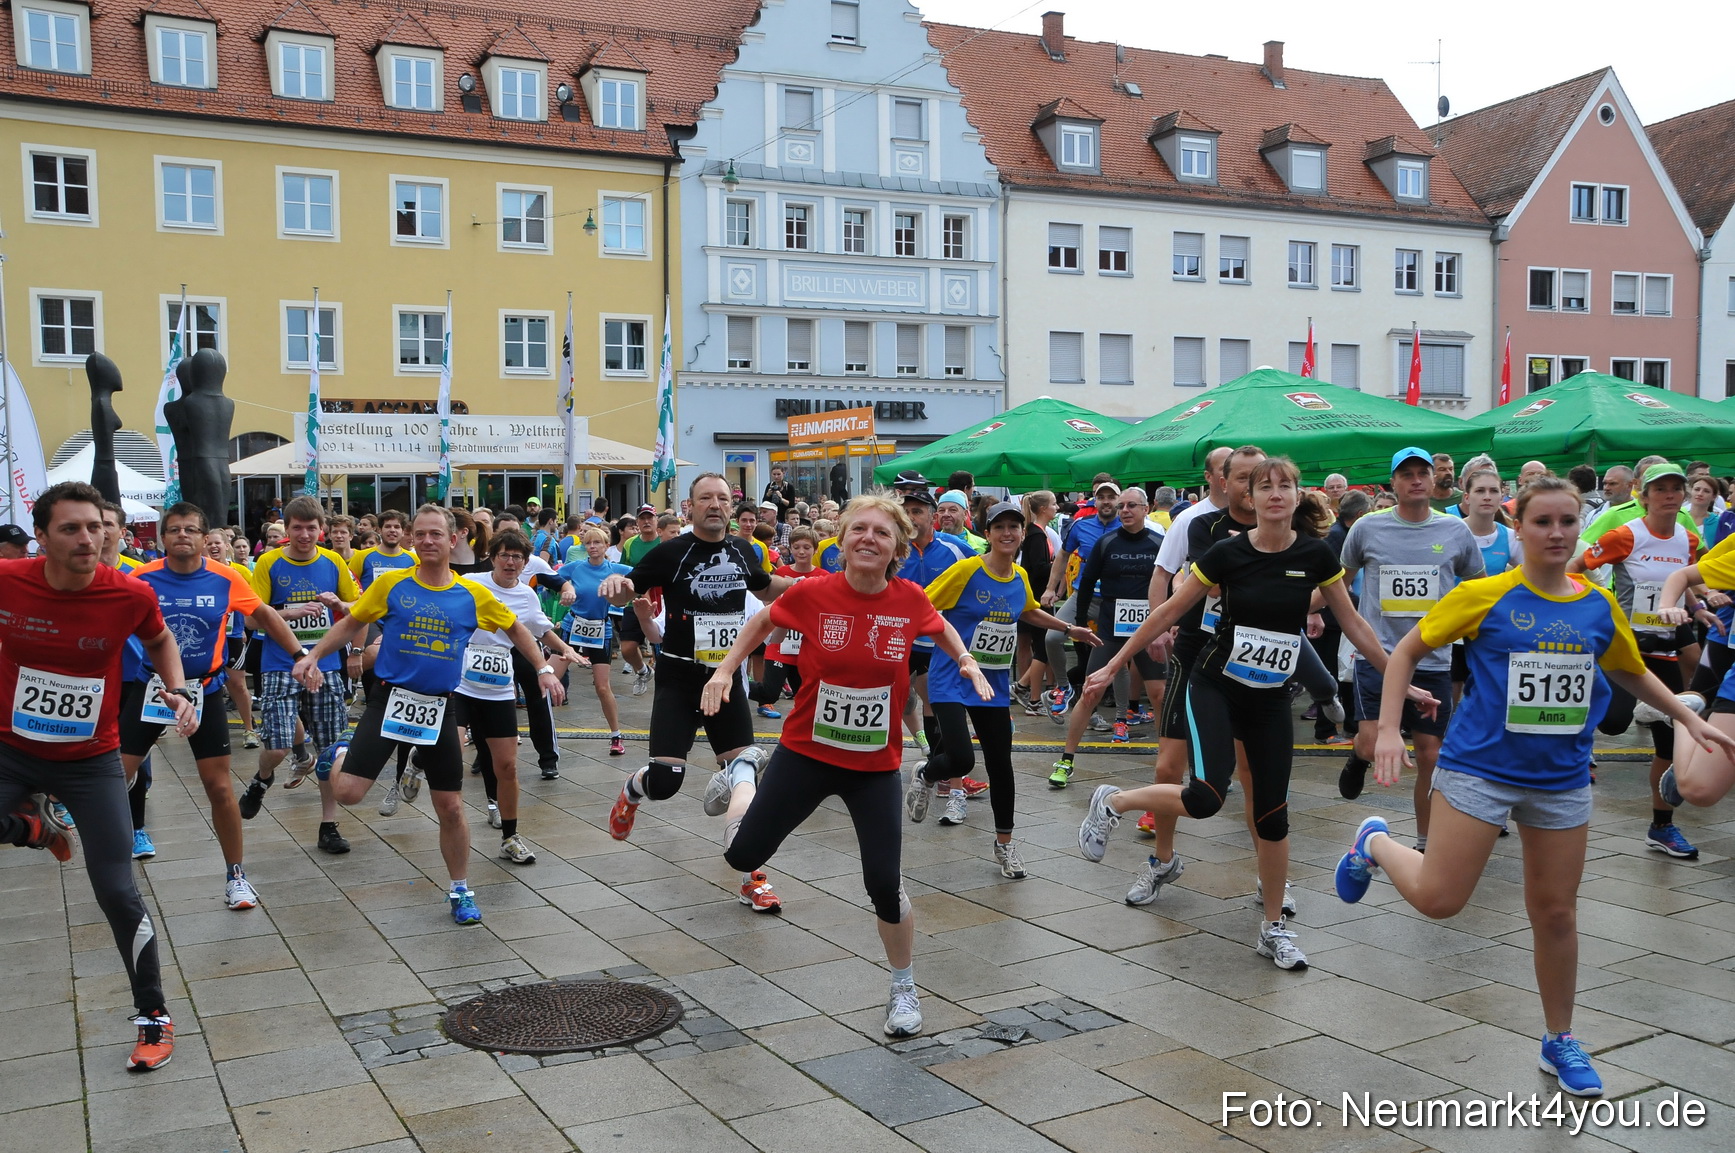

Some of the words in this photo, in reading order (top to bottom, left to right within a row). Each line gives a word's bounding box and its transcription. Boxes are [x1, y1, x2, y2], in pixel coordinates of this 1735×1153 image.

[792, 275, 856, 294] BRILLEN
[859, 278, 918, 298] WEBER
[305, 421, 393, 438] usstellung
[404, 423, 429, 436] 100
[438, 423, 478, 438] ahre
[488, 424, 500, 437] 1.
[509, 423, 567, 438] Weltkrie
[375, 442, 421, 453] 11.11.14
[1653, 556, 1684, 564] KLEBL
[702, 574, 739, 582] LAUFEN
[698, 582, 724, 590] GEGEN
[1392, 578, 1428, 597] 653
[824, 618, 848, 626] IMMER
[875, 615, 911, 624] NEUMARKTER
[1119, 608, 1150, 623] 2058
[574, 623, 602, 637] 2927
[823, 624, 848, 632] WIEDER
[874, 620, 905, 628] STADTLAUF
[976, 625, 994, 633] PARTL
[823, 630, 846, 640] NEU
[1236, 631, 1258, 641] PARTL
[1259, 635, 1291, 646] Neumarkt
[822, 638, 845, 646] MARKT
[976, 632, 1015, 652] 5218
[708, 652, 727, 661] Mich
[1237, 641, 1292, 672] 2448
[472, 654, 509, 675] 2650
[1511, 660, 1541, 669] PARTL
[1544, 661, 1582, 670] Neumarkt
[20, 673, 48, 686] PARTL
[49, 680, 89, 692] Neumarkt
[1248, 670, 1269, 682] Ruth
[1518, 672, 1586, 703] 5133
[820, 687, 844, 700] PARTL
[845, 693, 880, 702] Neumarkt
[22, 686, 93, 719] 2583
[157, 708, 176, 718] Mich
[391, 700, 438, 727] 2933
[822, 699, 884, 728] 5132
[1538, 710, 1566, 722] Anna
[27, 718, 77, 735] Christian
[397, 725, 423, 738] Patrick
[829, 728, 871, 743] Theresia
